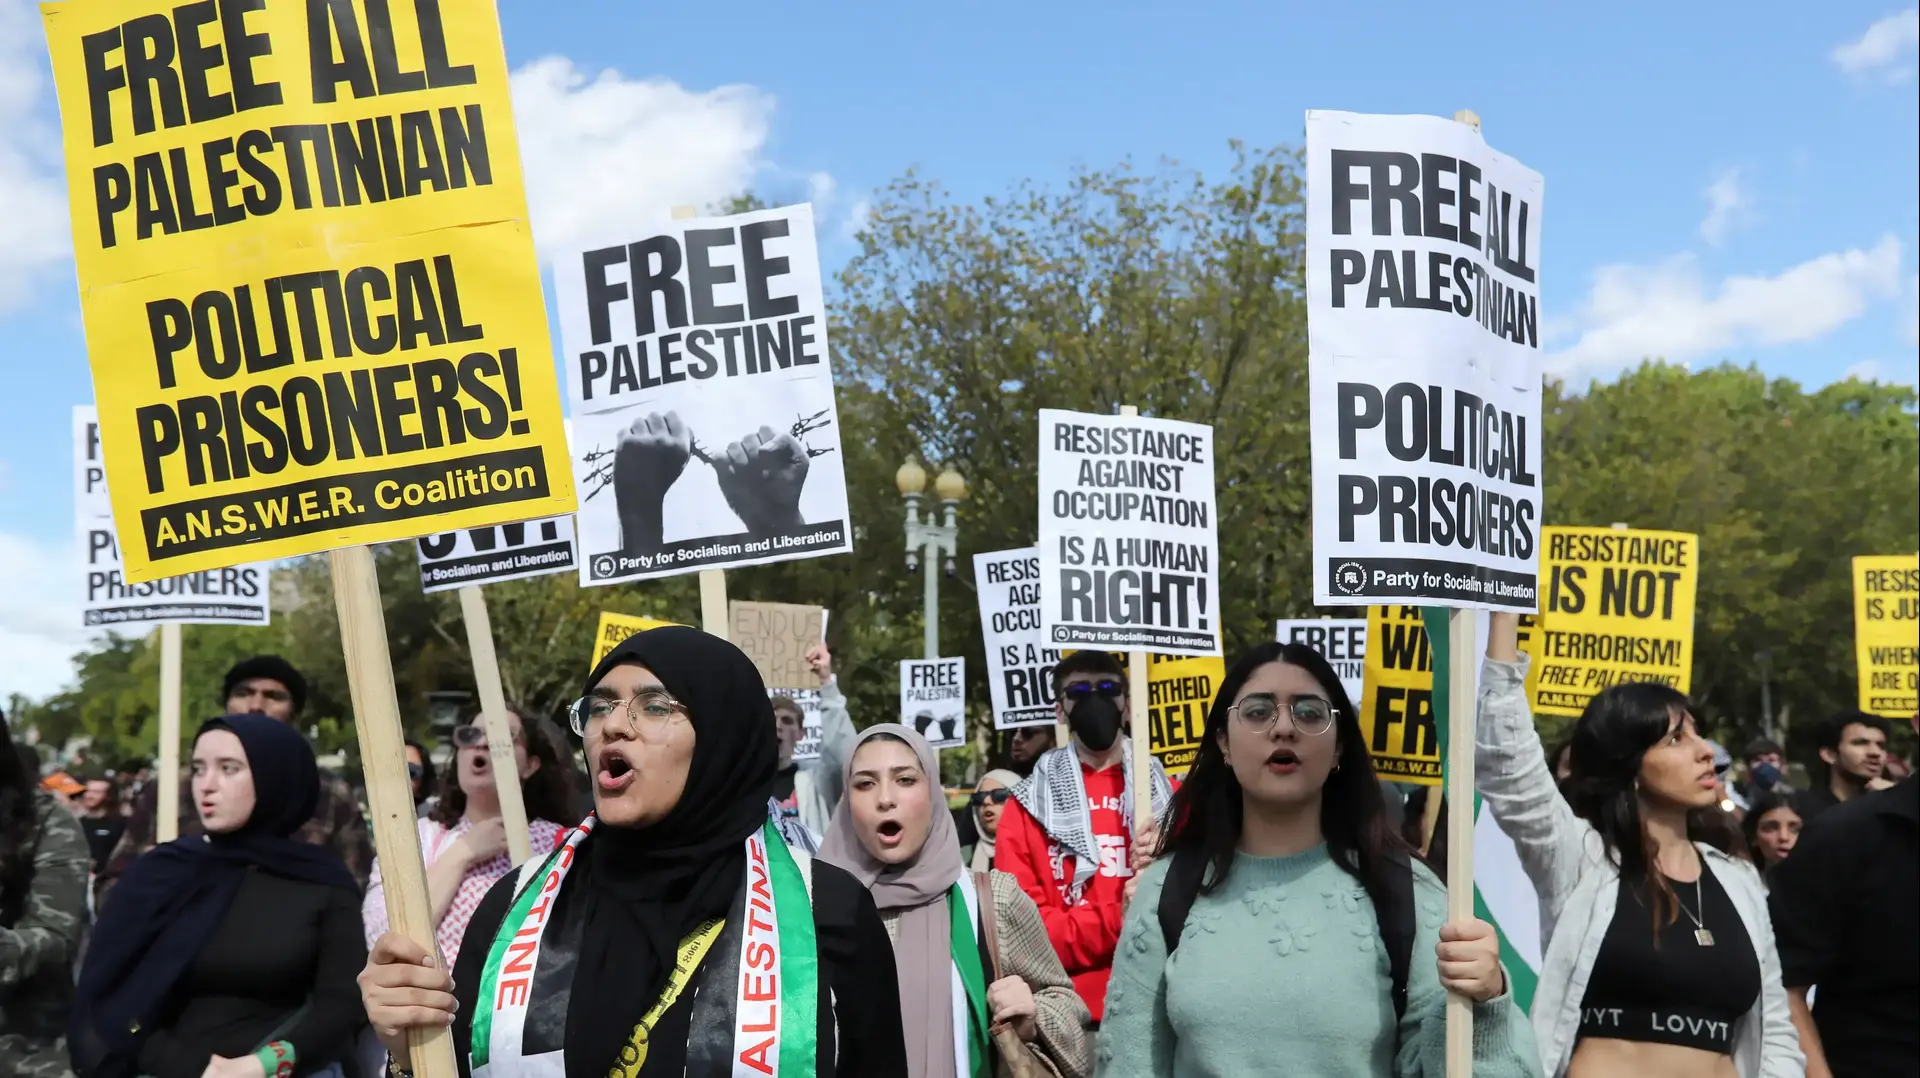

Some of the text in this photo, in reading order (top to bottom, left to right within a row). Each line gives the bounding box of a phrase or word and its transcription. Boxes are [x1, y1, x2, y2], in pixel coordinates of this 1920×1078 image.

[81, 0, 477, 149] FREE ALL
[92, 103, 494, 249] PALESTINIAN
[1331, 148, 1535, 284] FREE ALL
[582, 218, 799, 346] FREE
[1330, 248, 1537, 349] PALESTINIAN
[145, 254, 484, 390] POLITICAL
[579, 315, 820, 401] PALESTINE
[136, 347, 531, 494] PRISONERS!
[1337, 381, 1535, 487] POLITICAL
[1053, 422, 1204, 463] RESISTANCE
[1077, 459, 1184, 493] AGAINST
[155, 496, 366, 549] A.N.S.W.E.R.
[373, 463, 537, 513] Coalition
[1053, 489, 1208, 529] OCCUPATION
[1338, 474, 1534, 561] PRISONERS
[432, 562, 490, 580] Socialism
[492, 557, 513, 571] and
[514, 550, 570, 567] Liberation
[620, 530, 840, 570] Party for Socialism and Liberation
[1059, 535, 1208, 573] IS A HUMAN
[1550, 533, 1687, 567] RESISTANCE
[986, 557, 1040, 584] RESIS
[1373, 570, 1535, 599] Party for Socialism and Liberation
[1865, 569, 1919, 593] RESIS
[1009, 584, 1041, 606] AGA
[1060, 568, 1208, 630] RIGHT!
[1548, 565, 1681, 620] IS NOT
[1867, 598, 1918, 621] IS JU
[992, 608, 1041, 633] OCCU
[1000, 645, 1020, 667] IS
[1026, 643, 1038, 665] A
[1072, 630, 1096, 641] Party
[1097, 631, 1110, 640] for
[1112, 632, 1154, 642] Socialism
[1156, 635, 1171, 644] and
[1172, 635, 1213, 647] Liberation
[1290, 627, 1365, 659] FREE
[1544, 631, 1682, 667] TERRORISM!
[911, 663, 958, 687] FREE
[1148, 675, 1211, 705] RTHEID
[1540, 665, 1582, 688] FREE
[1871, 672, 1902, 690] ARE
[907, 687, 960, 701] PALESTINE
[1373, 686, 1437, 756] FR
[1098, 846, 1133, 877] SL
[1582, 1007, 1728, 1041] VYT LOVYT
